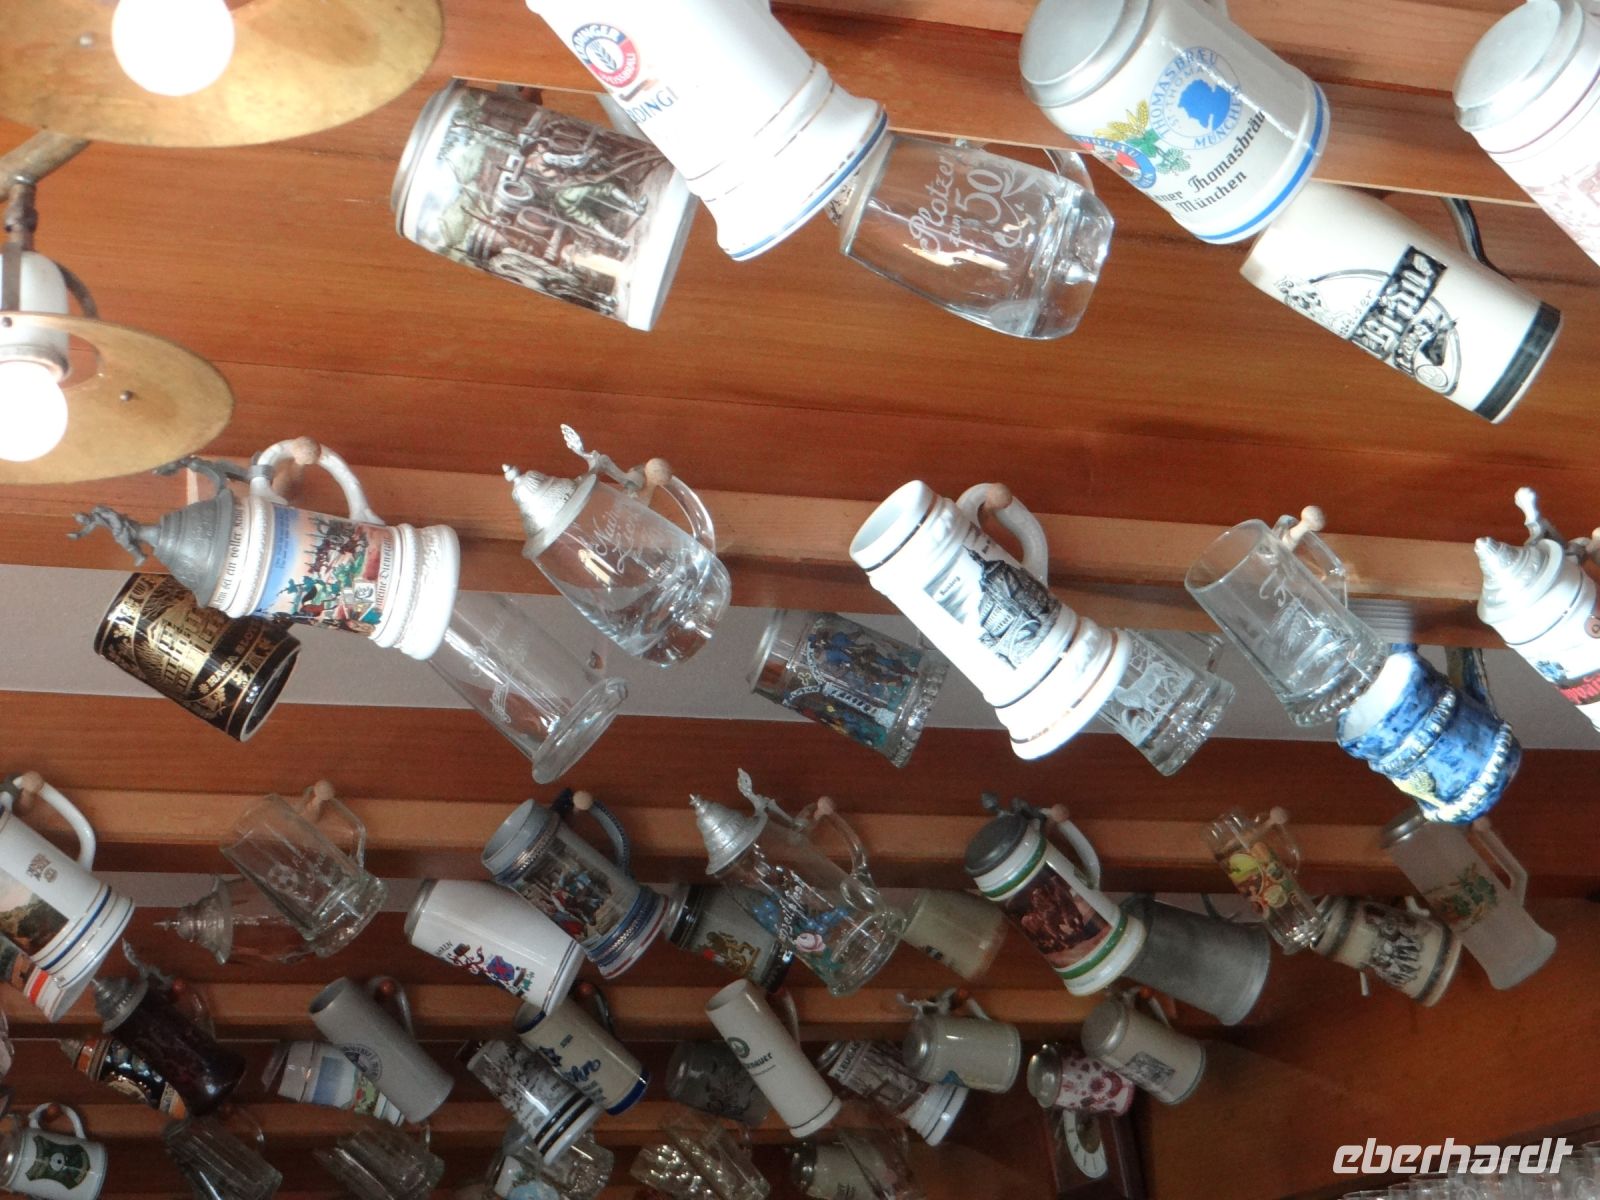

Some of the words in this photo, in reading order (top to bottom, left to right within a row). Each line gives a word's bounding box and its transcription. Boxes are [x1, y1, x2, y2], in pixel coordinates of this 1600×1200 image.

[1188, 110, 1266, 192] Thomasbräu
[955, 168, 1005, 225] 50
[1176, 171, 1247, 213] München
